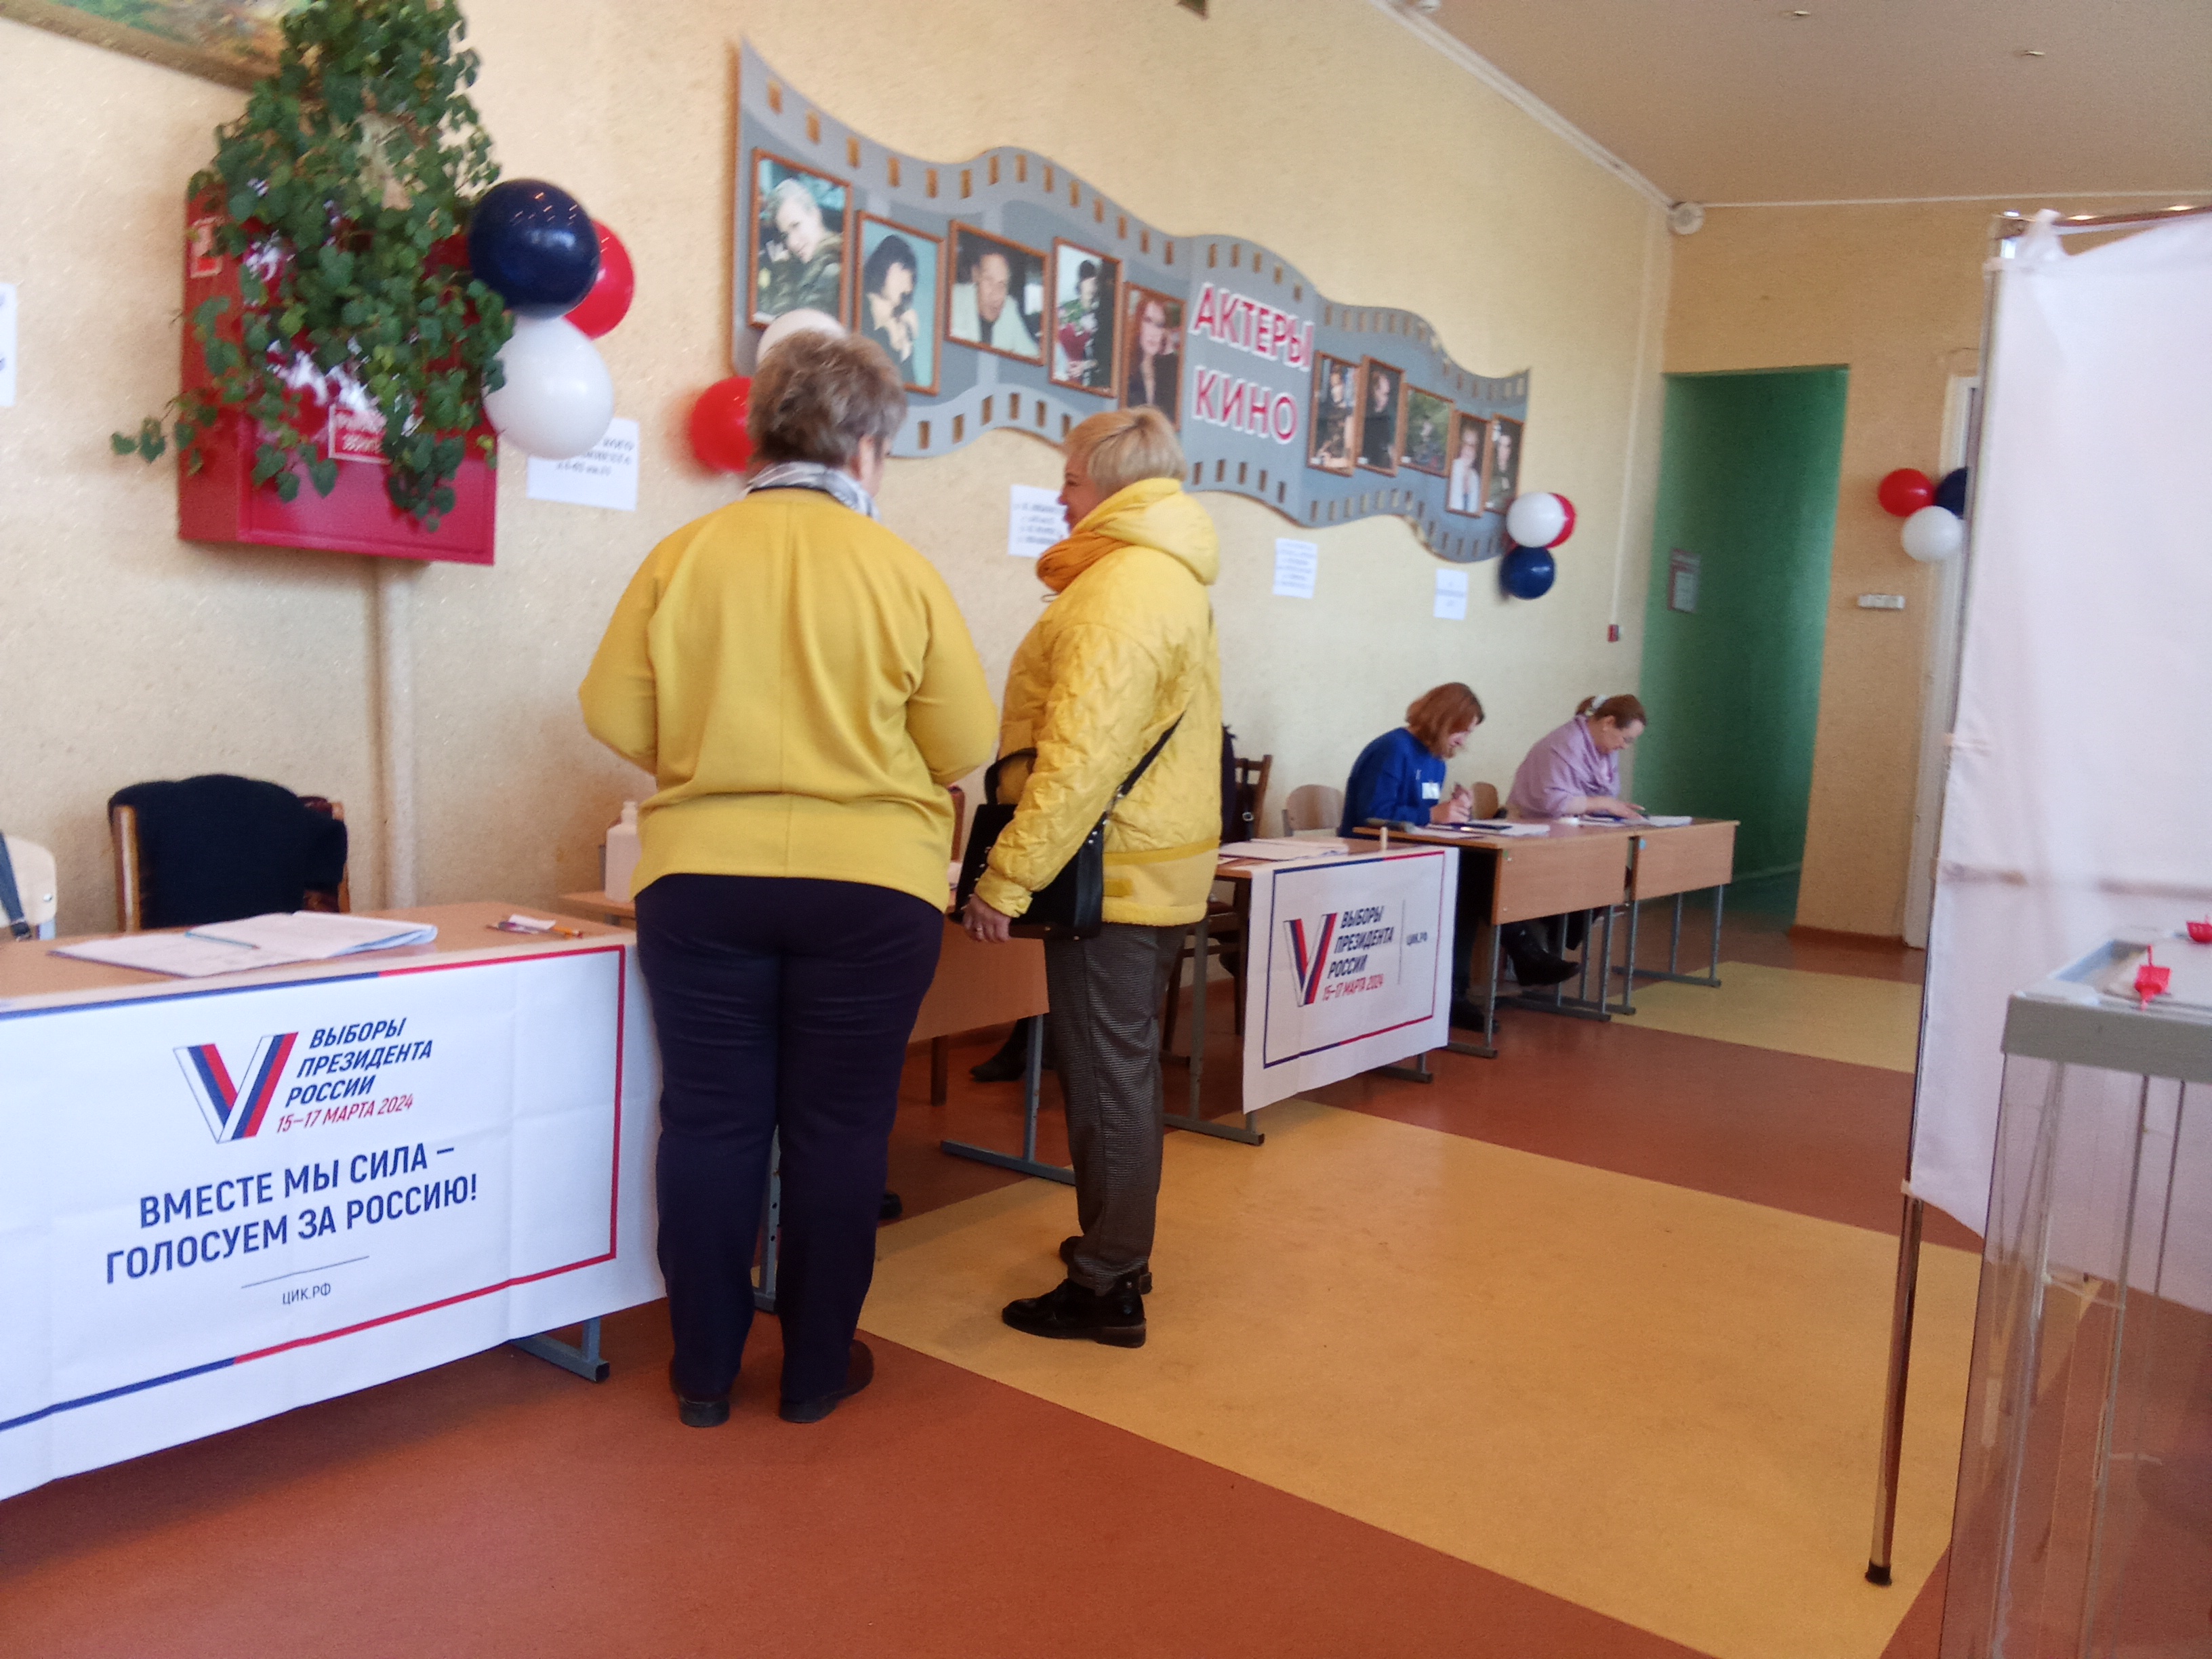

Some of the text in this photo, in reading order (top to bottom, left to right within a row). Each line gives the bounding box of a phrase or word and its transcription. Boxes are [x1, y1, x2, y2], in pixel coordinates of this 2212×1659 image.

[1188, 282, 1315, 372] АКТЕРЫ
[1192, 365, 1298, 445] КИНО
[1340, 905, 1385, 928] ВЫБОРЫ
[1334, 926, 1395, 954] ПРЕЗИДЕНТА
[1327, 954, 1368, 979] РОССИИ
[308, 1017, 407, 1049] ВЫБОРЫ
[296, 1040, 433, 1078] ПРЕЗИДЕНТА
[285, 1075, 376, 1108] РОССИИ
[322, 1100, 375, 1125] МАРТА
[377, 1093, 414, 1115] 2024
[140, 1172, 273, 1229] ВМЕСТЕ
[284, 1159, 339, 1198] МЫ
[350, 1143, 428, 1183] СИЛА
[106, 1173, 476, 1284] ГОЛОСУЕМ ЗА РОССИЮ!
[281, 1282, 331, 1305] ЦИК.РФ
